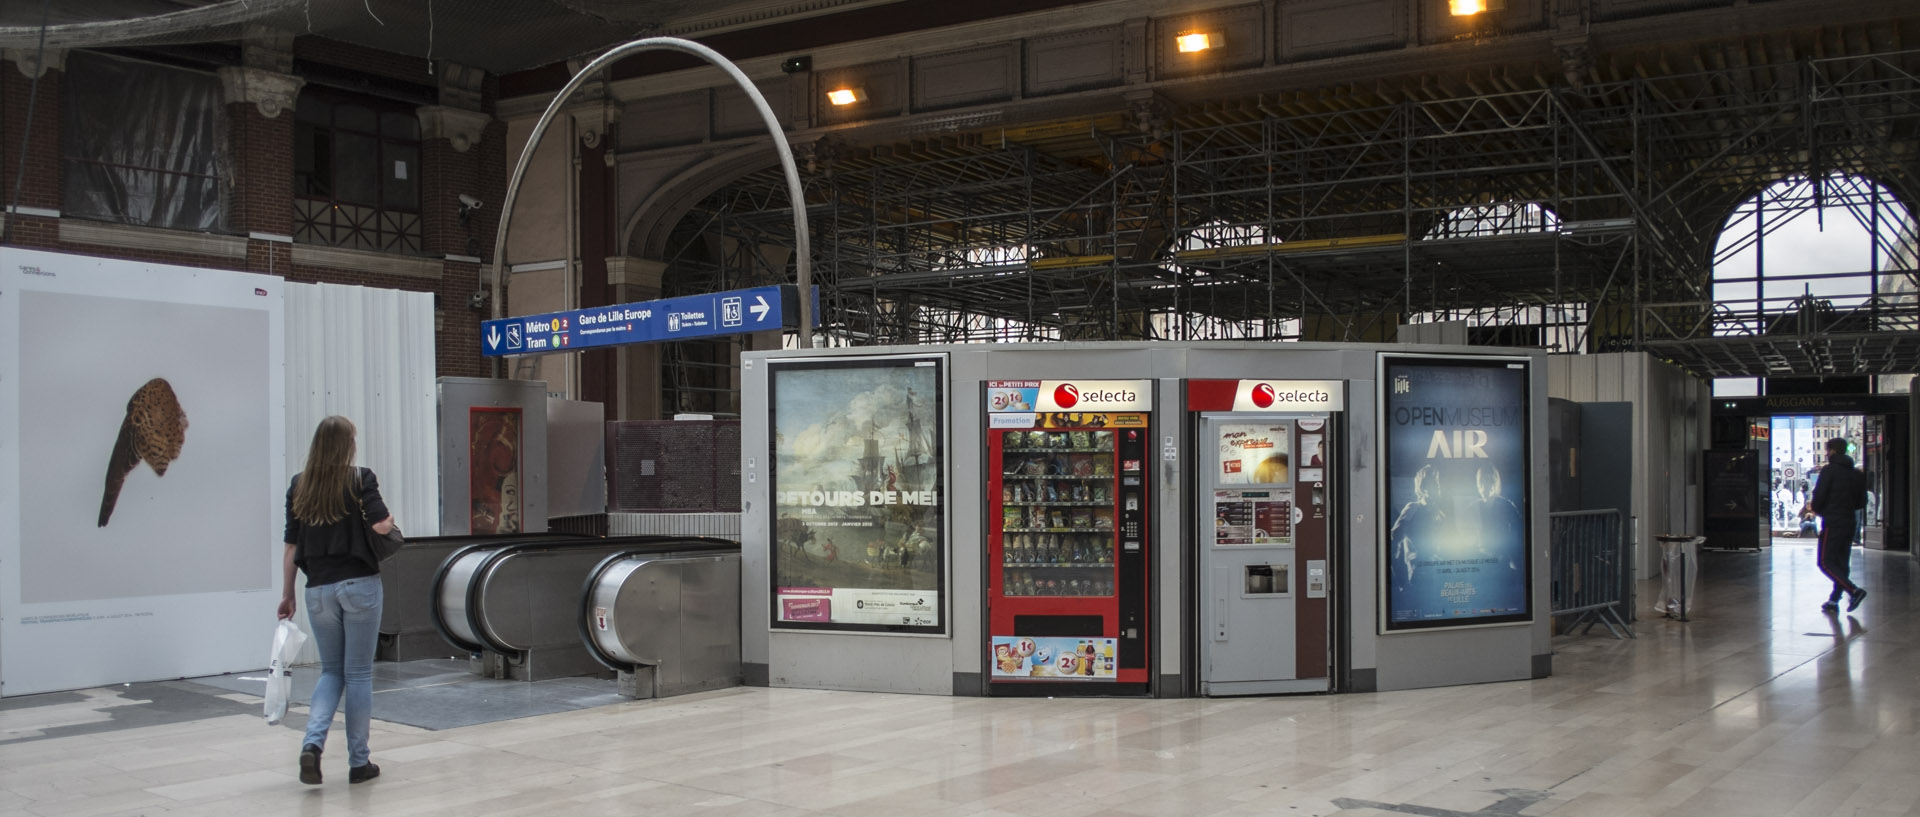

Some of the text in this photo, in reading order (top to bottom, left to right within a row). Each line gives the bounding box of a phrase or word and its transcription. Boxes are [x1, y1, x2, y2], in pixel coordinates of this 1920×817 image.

[579, 309, 652, 325] Gare de Lille Europe
[680, 312, 705, 320] Toilettes
[526, 321, 550, 333] Métro
[562, 319, 568, 328] 2
[526, 337, 547, 348] Tram
[562, 336, 569, 345] T
[1082, 389, 1136, 403] selecta
[1278, 389, 1329, 403] selecta
[1766, 397, 1825, 407] AUSGANG
[993, 417, 1031, 425] Promotion
[1426, 429, 1489, 459] AIR
[869, 490, 897, 506] DE
